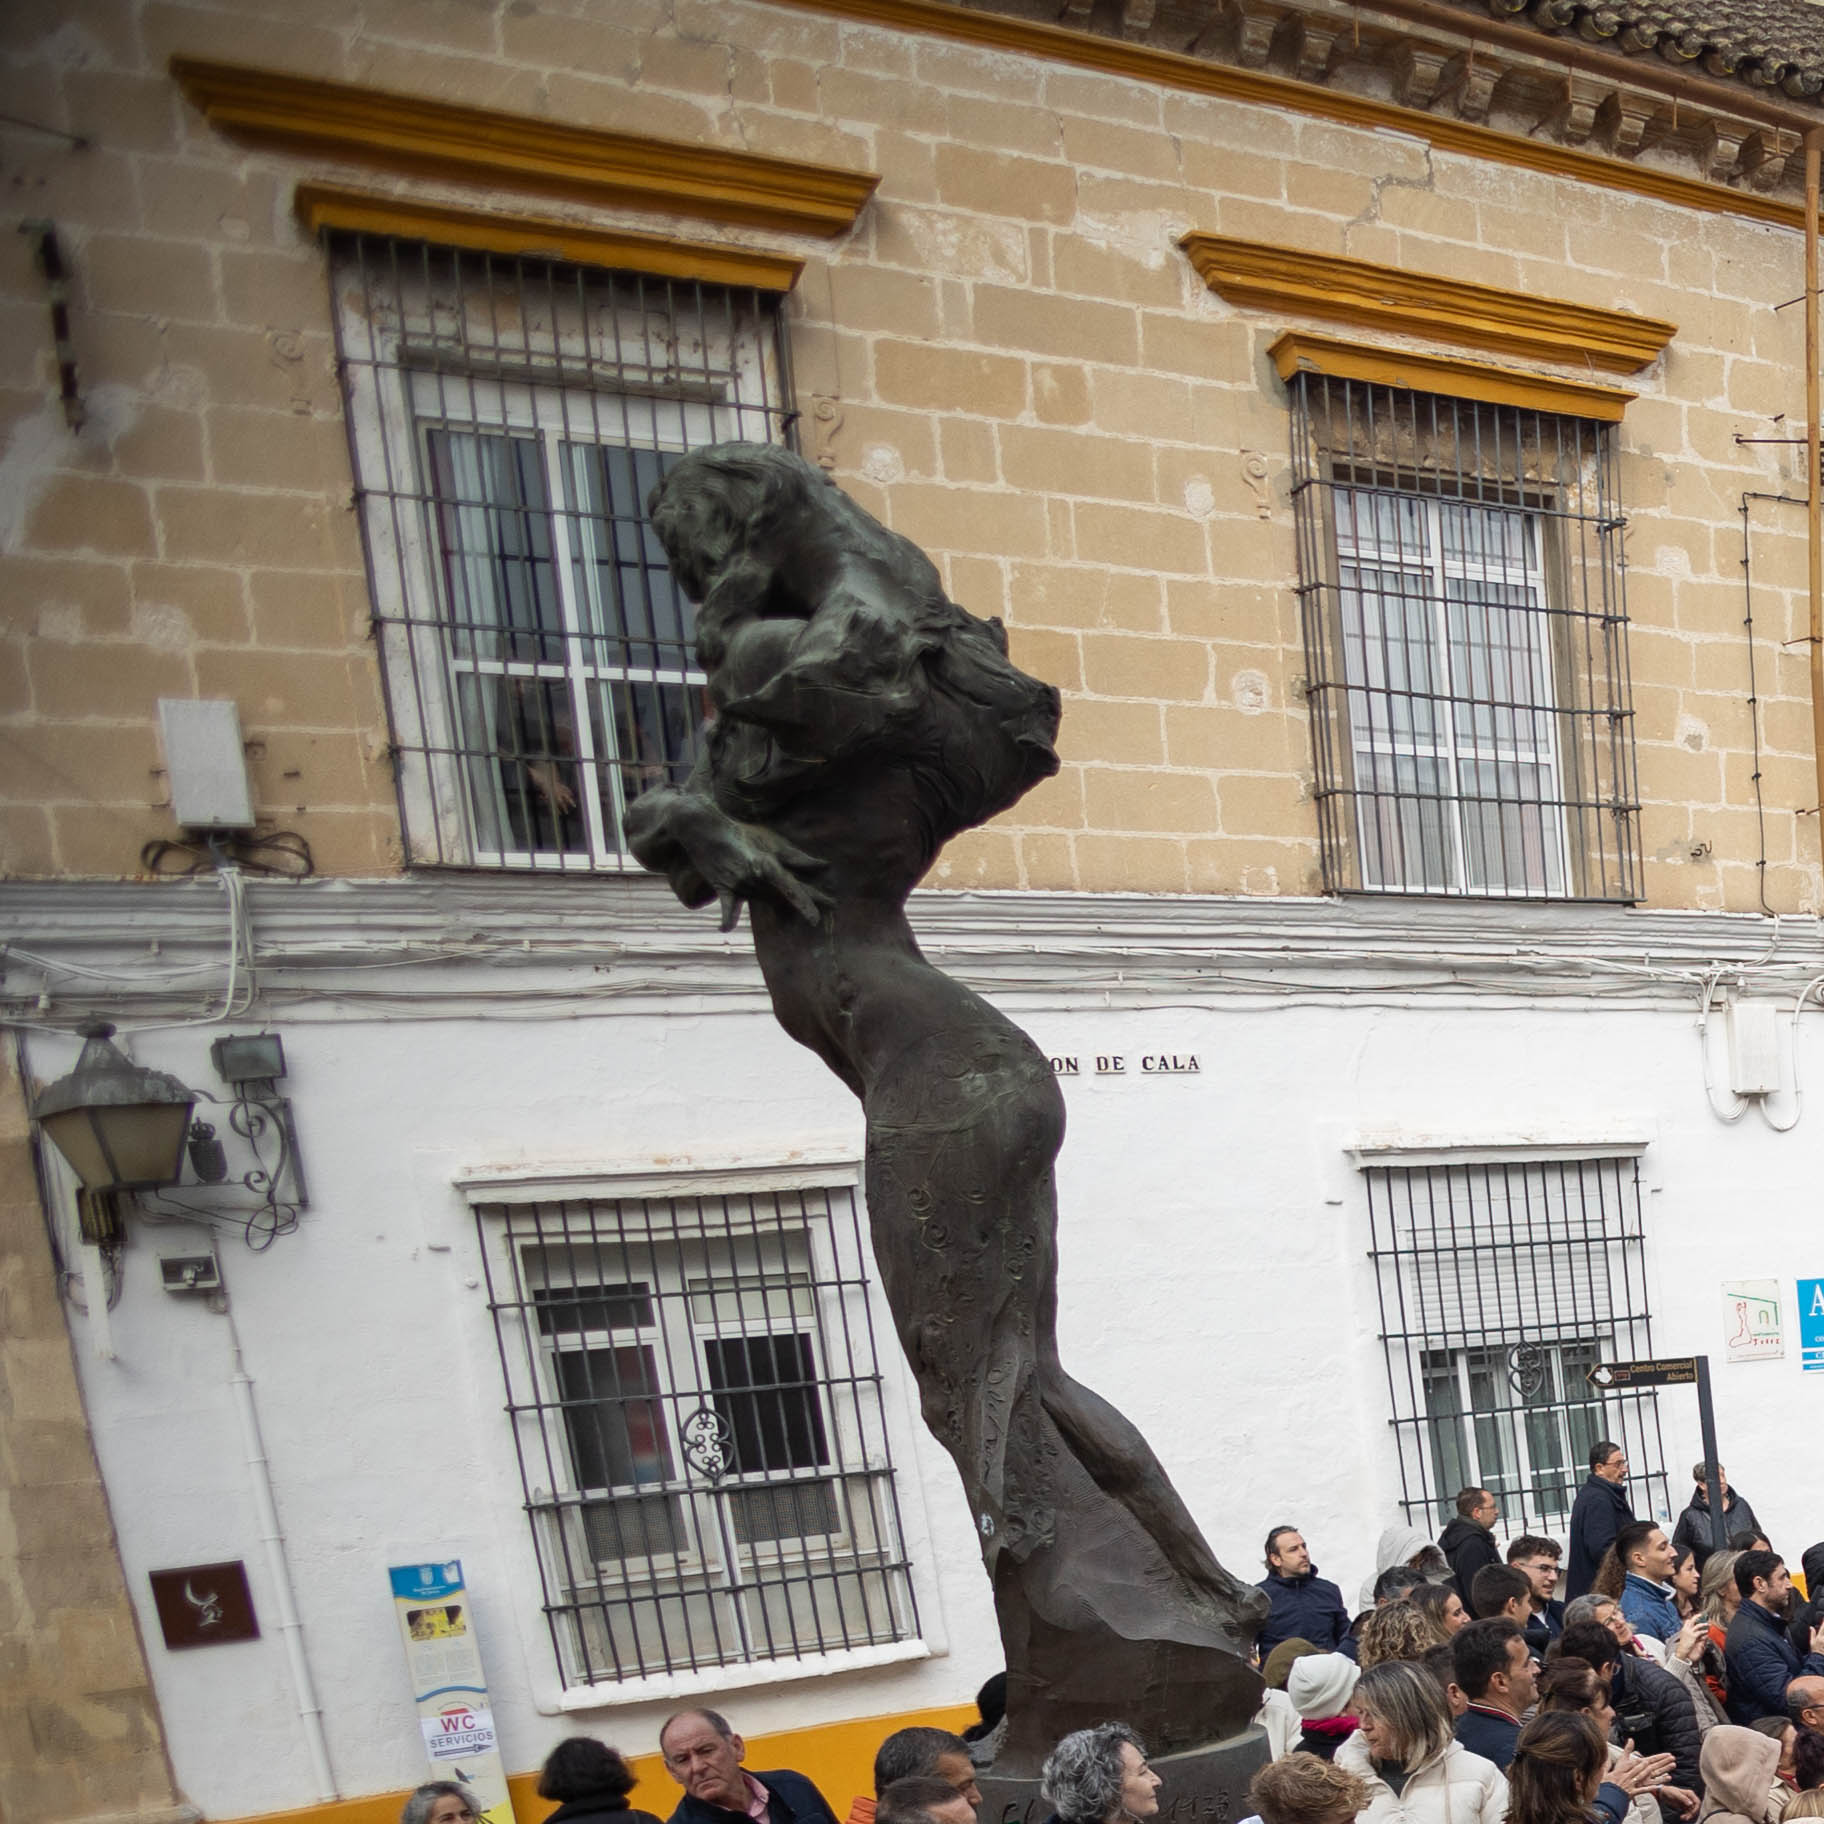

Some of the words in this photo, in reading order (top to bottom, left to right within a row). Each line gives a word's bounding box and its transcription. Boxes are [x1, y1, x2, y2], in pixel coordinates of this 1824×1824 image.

[1096, 1056, 1125, 1072] DE
[1141, 1055, 1200, 1071] CALA
[1629, 1364, 1656, 1373] Centro
[1656, 1360, 1693, 1372] Comercial
[440, 1714, 476, 1733] WC
[430, 1730, 494, 1749] SERVICIOS
